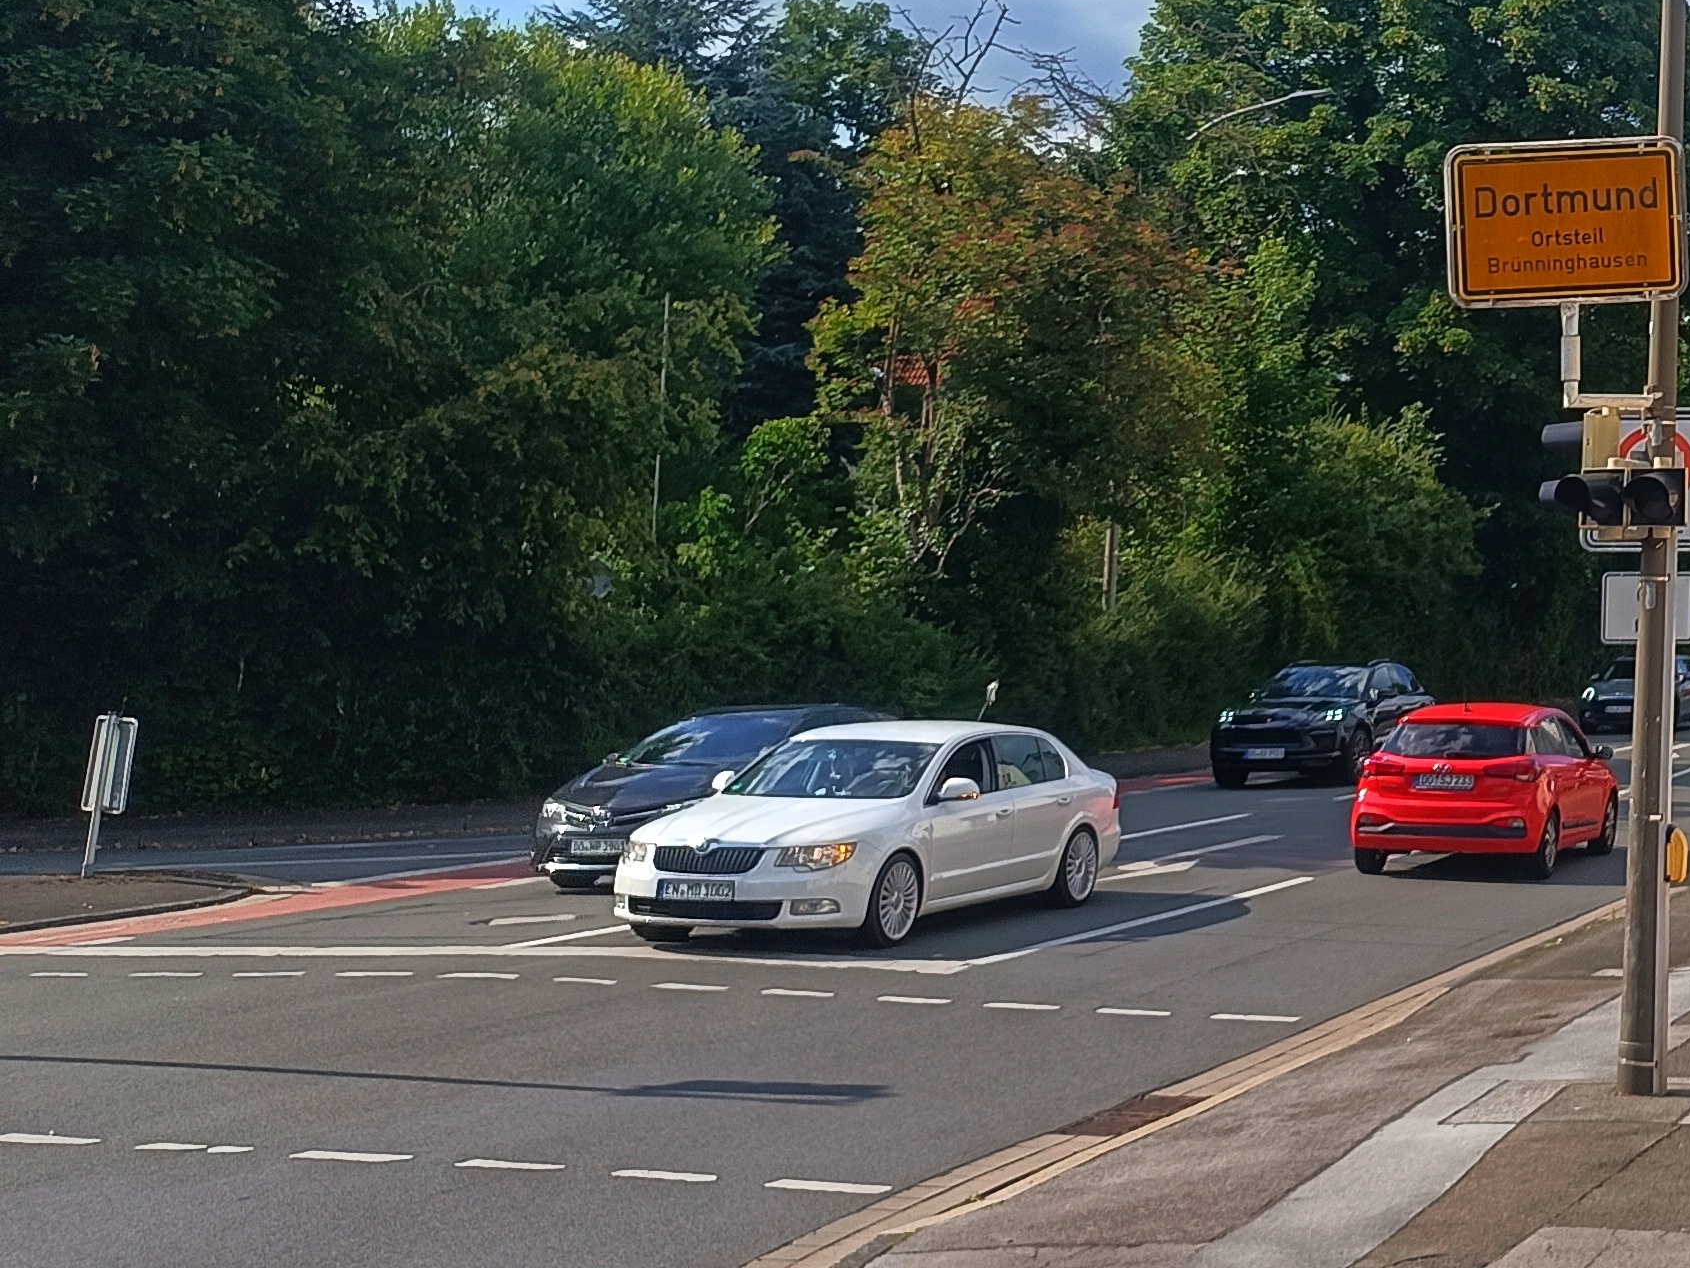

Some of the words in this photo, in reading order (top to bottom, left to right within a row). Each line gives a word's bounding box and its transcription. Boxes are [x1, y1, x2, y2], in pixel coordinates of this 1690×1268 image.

[1474, 177, 1658, 219] Dortmund
[1531, 227, 1604, 247] Ortsteil
[1487, 253, 1648, 274] Brünninghausen
